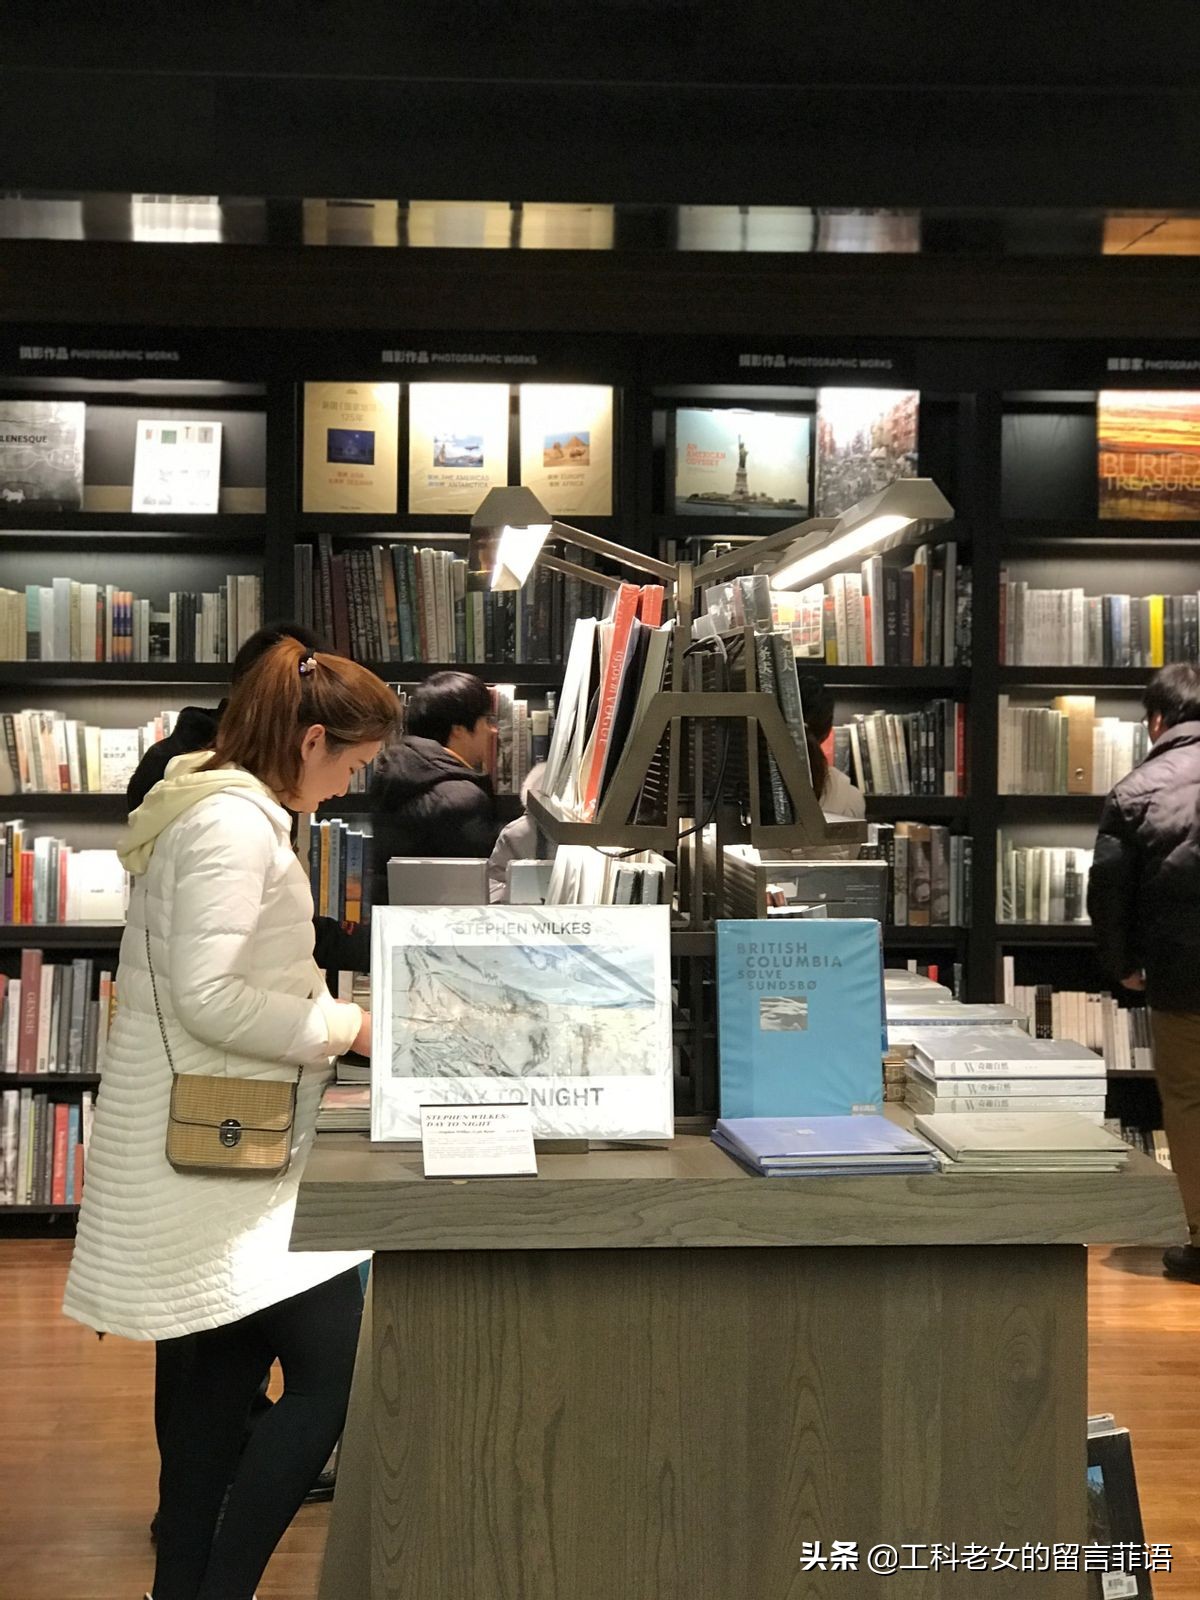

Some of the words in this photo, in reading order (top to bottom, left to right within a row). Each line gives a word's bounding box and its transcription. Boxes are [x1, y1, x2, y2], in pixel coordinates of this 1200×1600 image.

[70, 349, 143, 361] PHOTOGRAPHIC
[145, 350, 180, 361] WORKS
[431, 353, 501, 364] PHOTOGRAPHIC
[504, 355, 538, 365] WORKS
[788, 357, 858, 368] PHOTOGRAPHIC
[860, 358, 893, 369] WORKS
[612, 651, 623, 680] 1950s
[600, 695, 616, 742] VOGUE
[454, 923, 528, 935] STEPHEN
[532, 922, 591, 935] WILKES
[737, 942, 808, 955] BRITISH
[746, 956, 843, 968] COLUMBIA
[26, 992, 36, 1035] GENESIS
[531, 1088, 604, 1106] NIGHT
